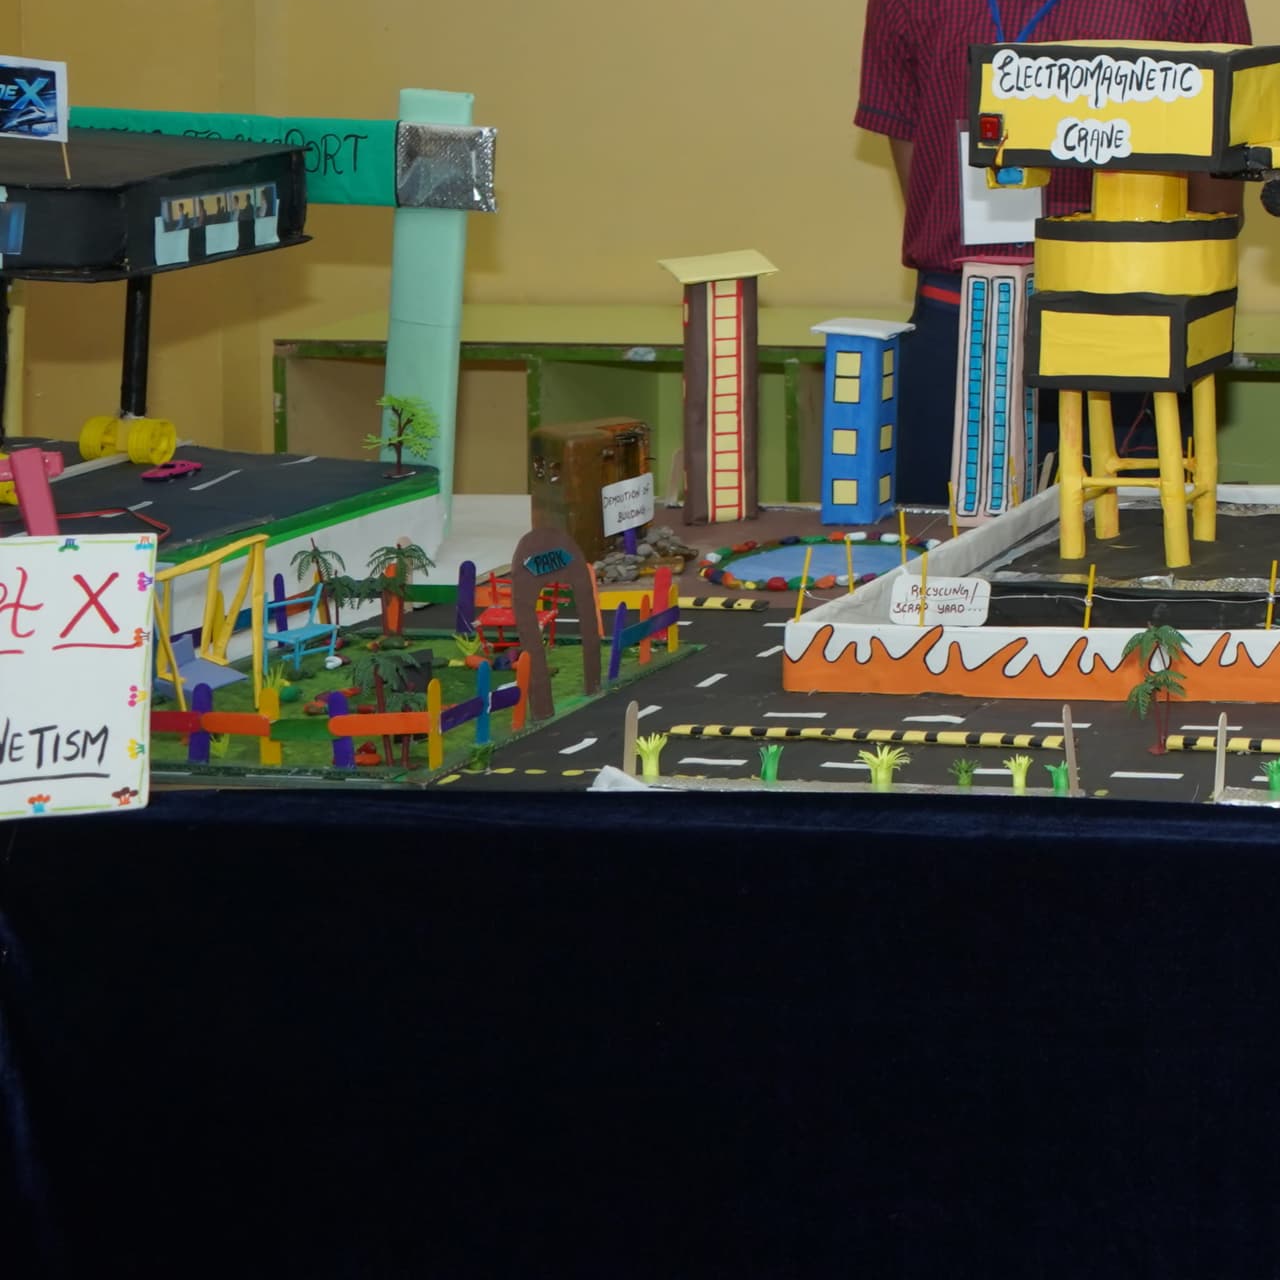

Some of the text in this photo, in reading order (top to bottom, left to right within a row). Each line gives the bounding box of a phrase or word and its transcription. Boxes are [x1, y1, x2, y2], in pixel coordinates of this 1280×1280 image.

[998, 55, 1194, 108] ELECTROMAGNETIC
[1063, 122, 1124, 160] CRANE
[533, 549, 566, 574] PARK
[59, 572, 120, 639] X
